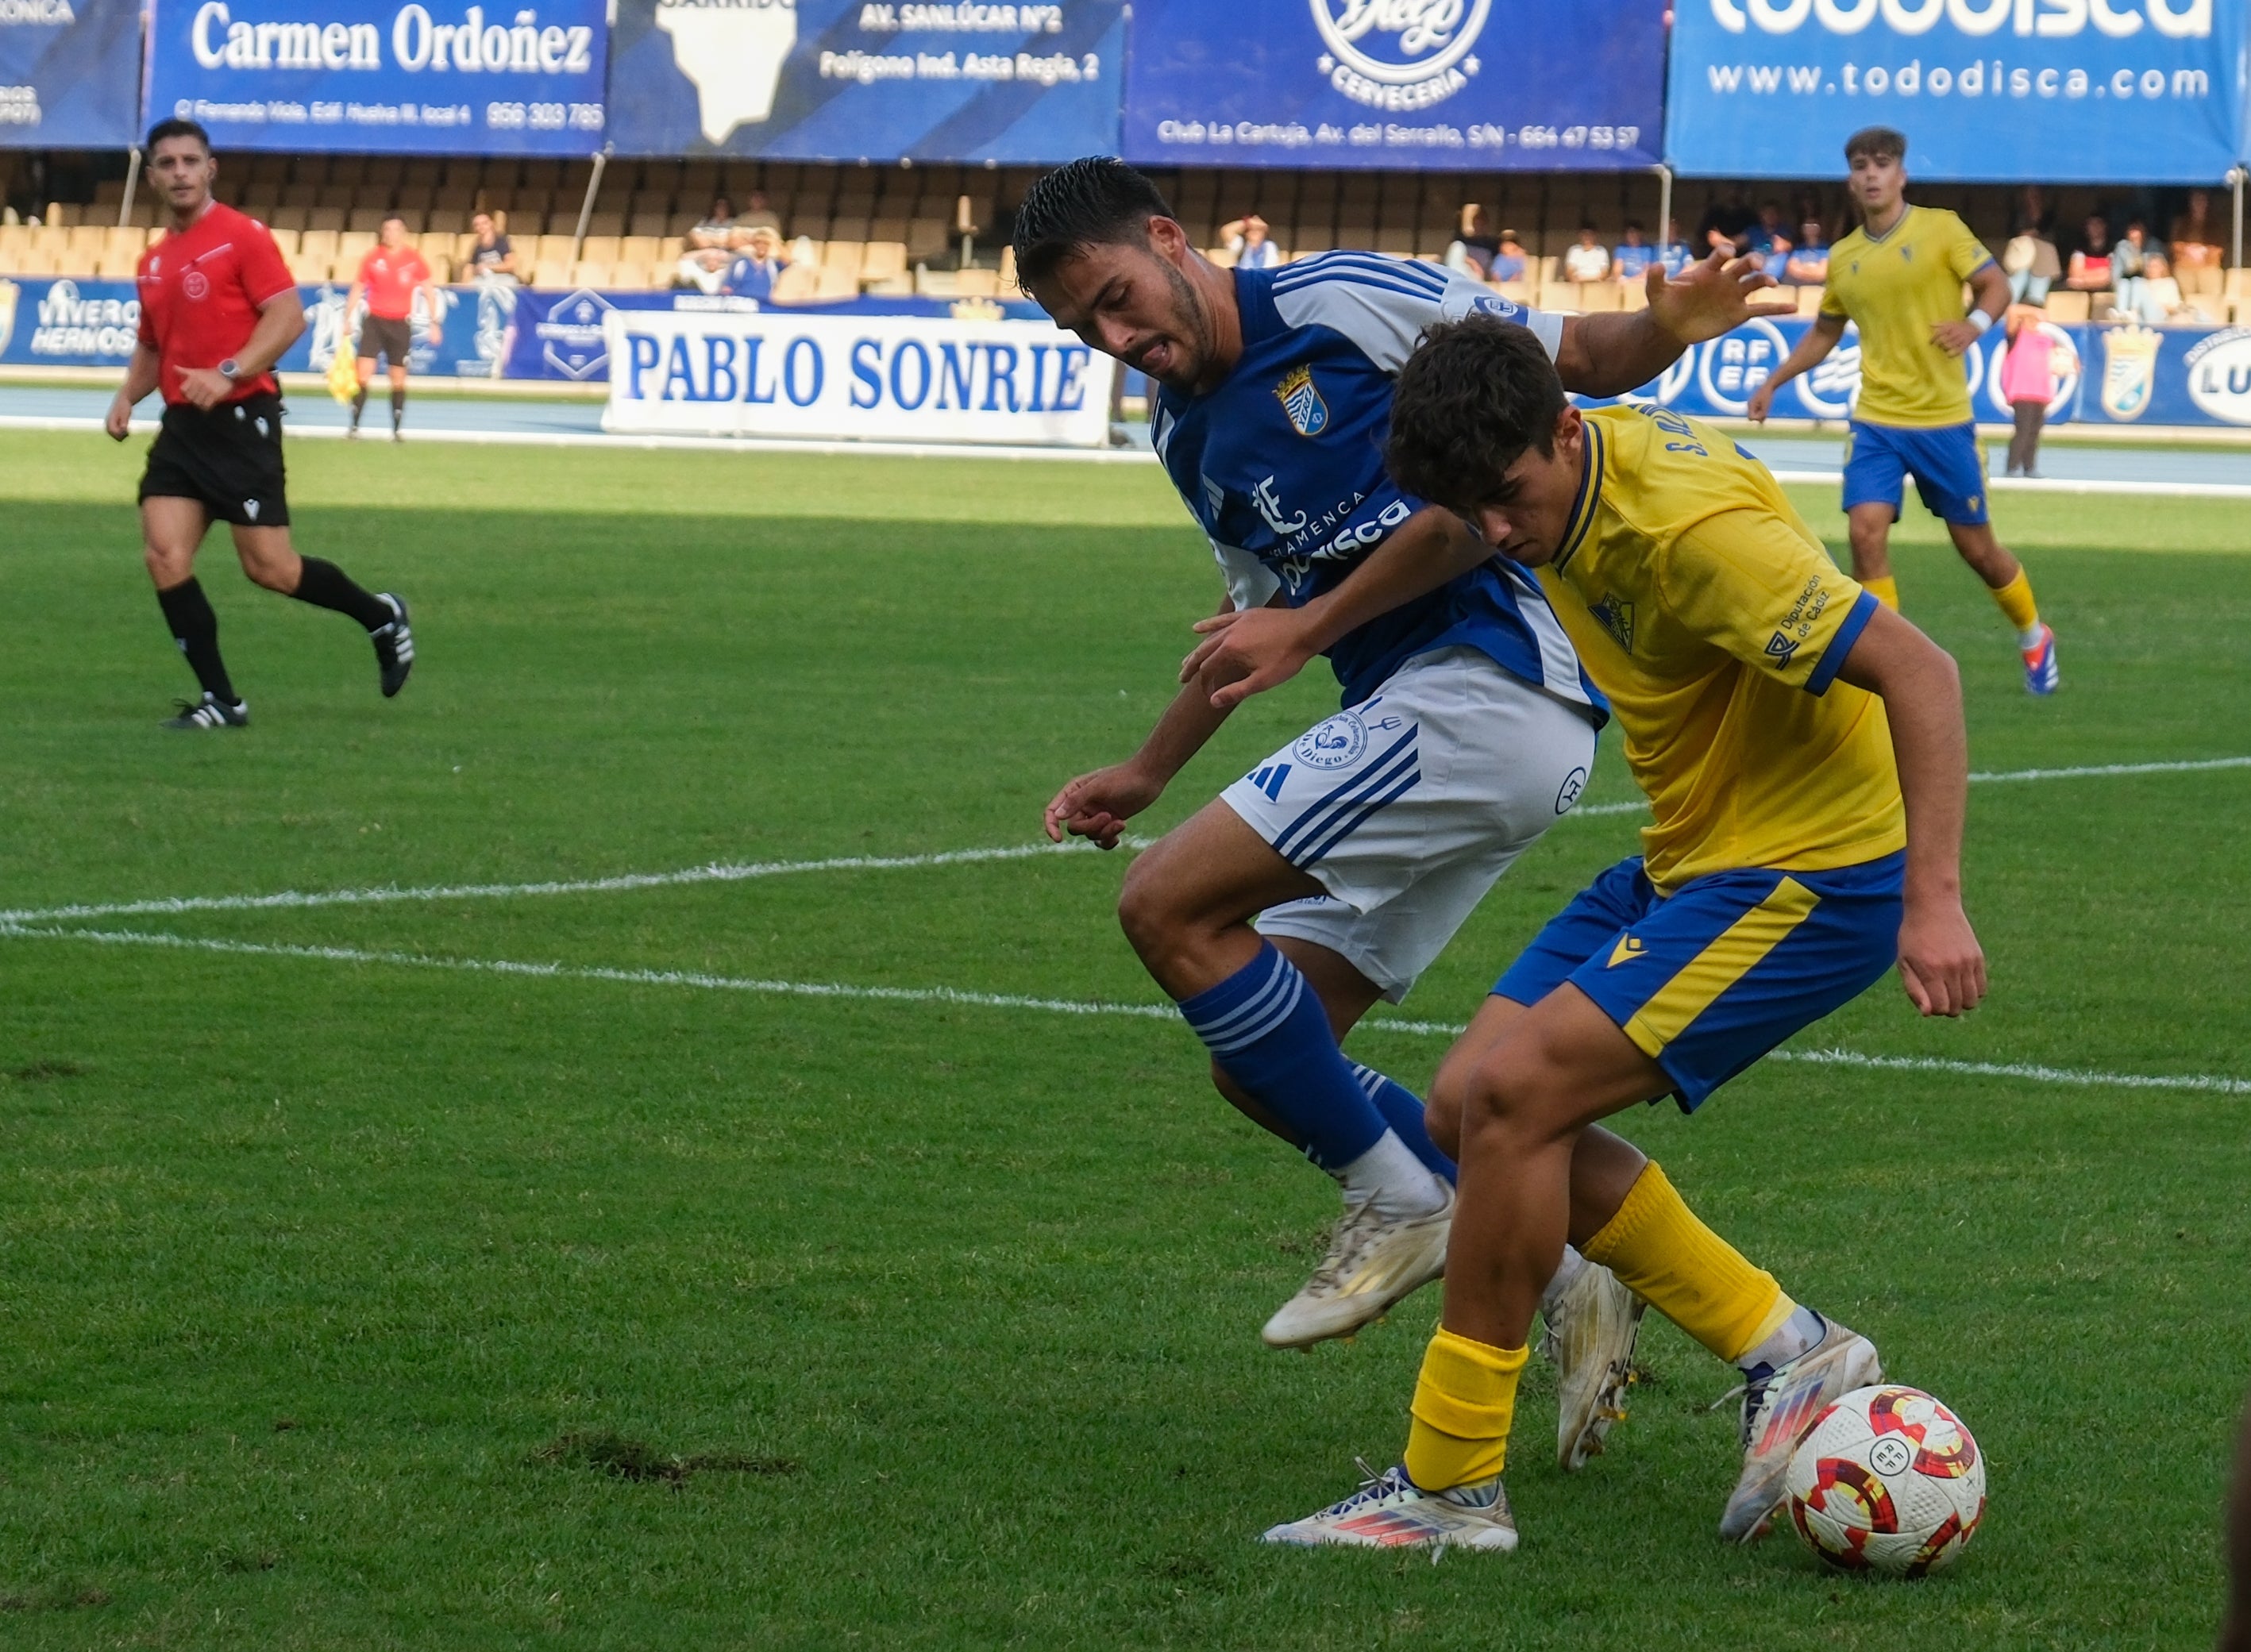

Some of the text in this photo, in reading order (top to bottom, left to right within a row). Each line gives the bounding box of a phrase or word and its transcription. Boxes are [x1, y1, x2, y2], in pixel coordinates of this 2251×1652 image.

[858, 3, 899, 32] AV.
[900, 0, 1019, 32] SANLÚCAR
[191, 2, 593, 74] Carmen Ordoñez
[819, 50, 915, 85] Polígono
[916, 52, 960, 79] Ind.
[962, 52, 1014, 80] Asta
[1082, 53, 1100, 81] 2
[1708, 58, 2210, 99] www.tododisca.com
[487, 102, 526, 129] 956
[1157, 120, 1206, 144] Club
[1208, 121, 1233, 144] La
[1314, 122, 1347, 146] Av.
[1349, 122, 1382, 147] del
[1519, 125, 1559, 150] 664
[1561, 125, 1588, 149] 47
[1590, 125, 1615, 150] 53
[1615, 126, 1640, 151] 57
[1721, 337, 1772, 364] RF
[626, 331, 1091, 414] PABLO SONRIE
[1717, 365, 1771, 392] EF
[1781, 574, 1821, 630] Diputación
[1798, 591, 1830, 637] de Cádiz
[1301, 748, 1342, 764] Diego
